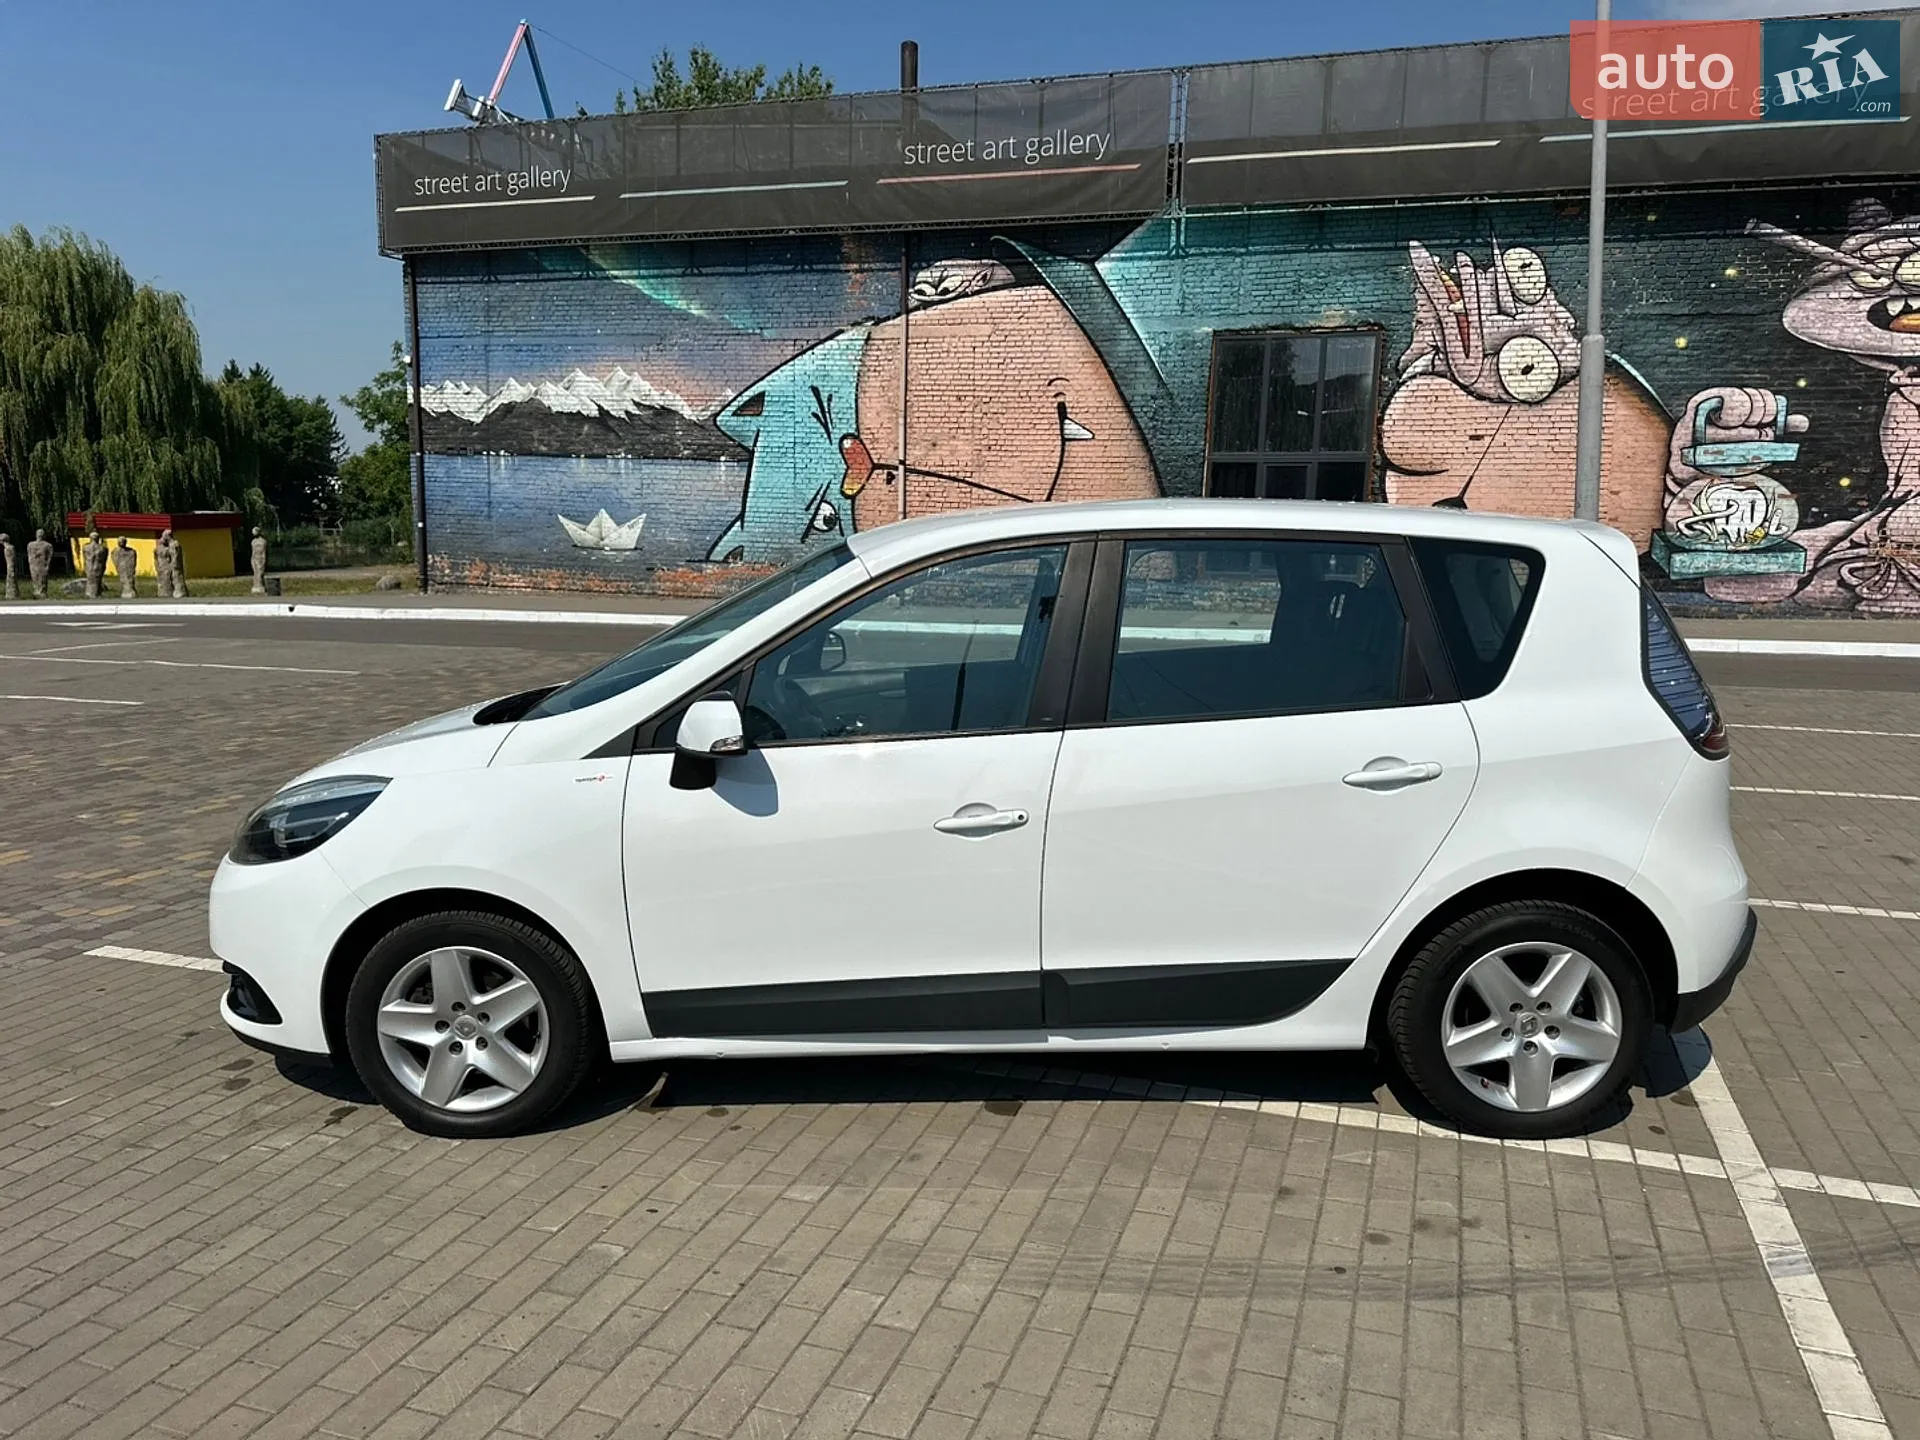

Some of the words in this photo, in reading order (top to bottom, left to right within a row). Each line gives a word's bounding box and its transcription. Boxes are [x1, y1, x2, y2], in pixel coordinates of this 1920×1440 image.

[1581, 88, 1680, 119] sreet
[1690, 83, 1740, 112] art
[903, 139, 975, 165] street
[982, 136, 1019, 160] art
[1024, 128, 1111, 165] gallery
[414, 173, 470, 196] street
[474, 171, 502, 192] art
[506, 164, 571, 196] gallery
